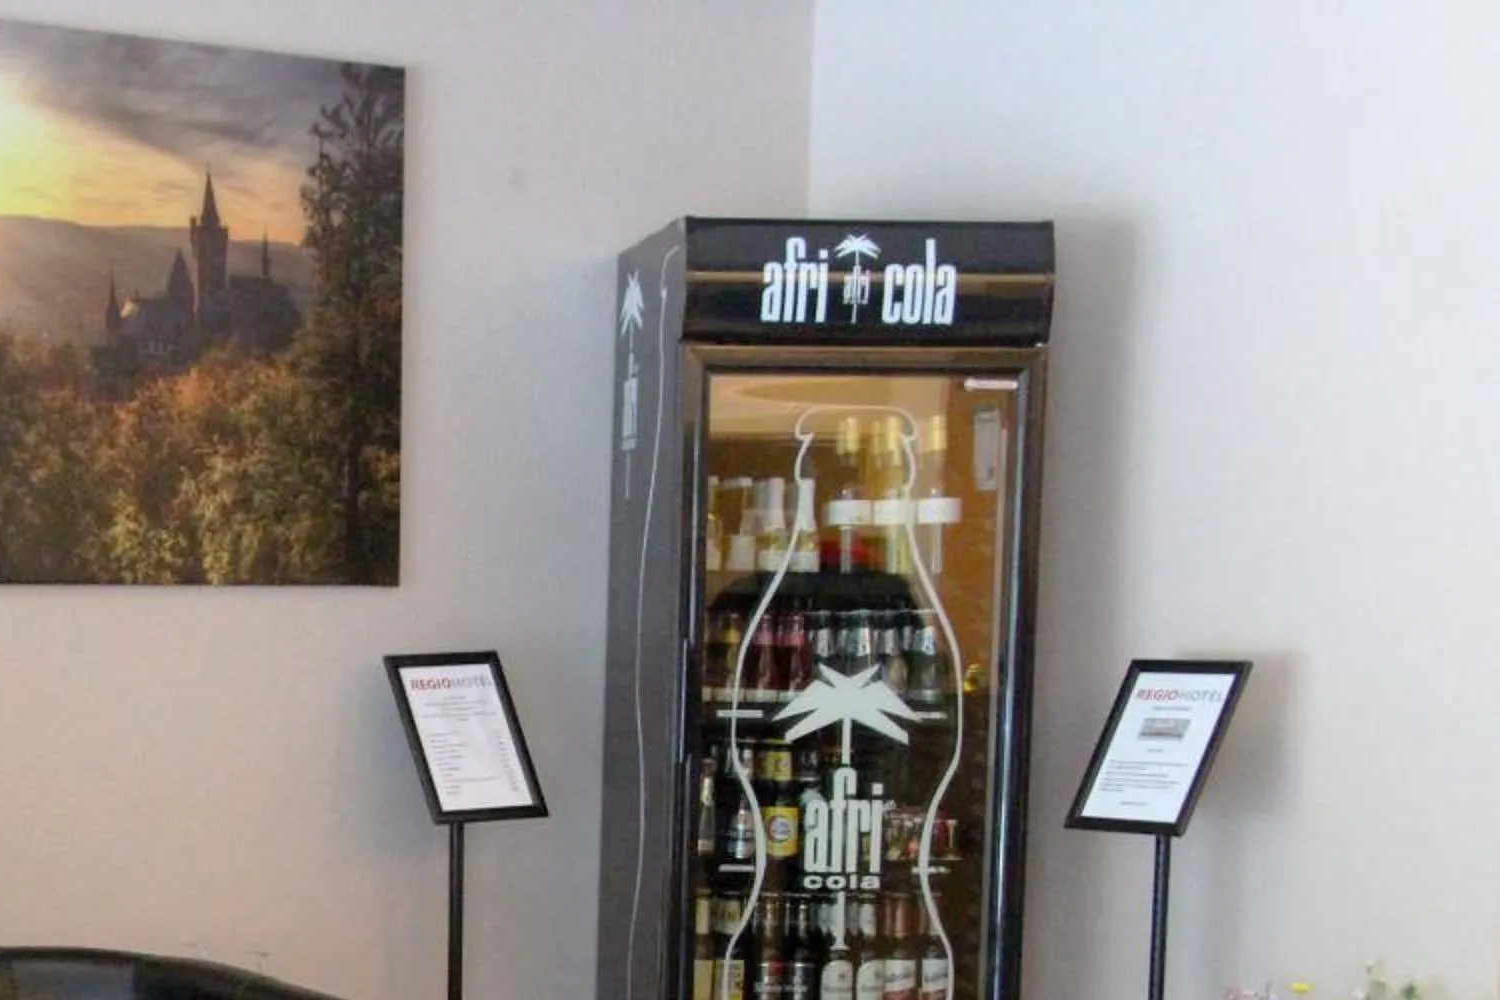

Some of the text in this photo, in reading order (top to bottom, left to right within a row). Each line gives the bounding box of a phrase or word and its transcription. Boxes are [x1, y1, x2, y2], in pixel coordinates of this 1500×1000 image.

[760, 236, 957, 325] afri cola
[803, 767, 884, 873] afri
[803, 875, 880, 890] cola
